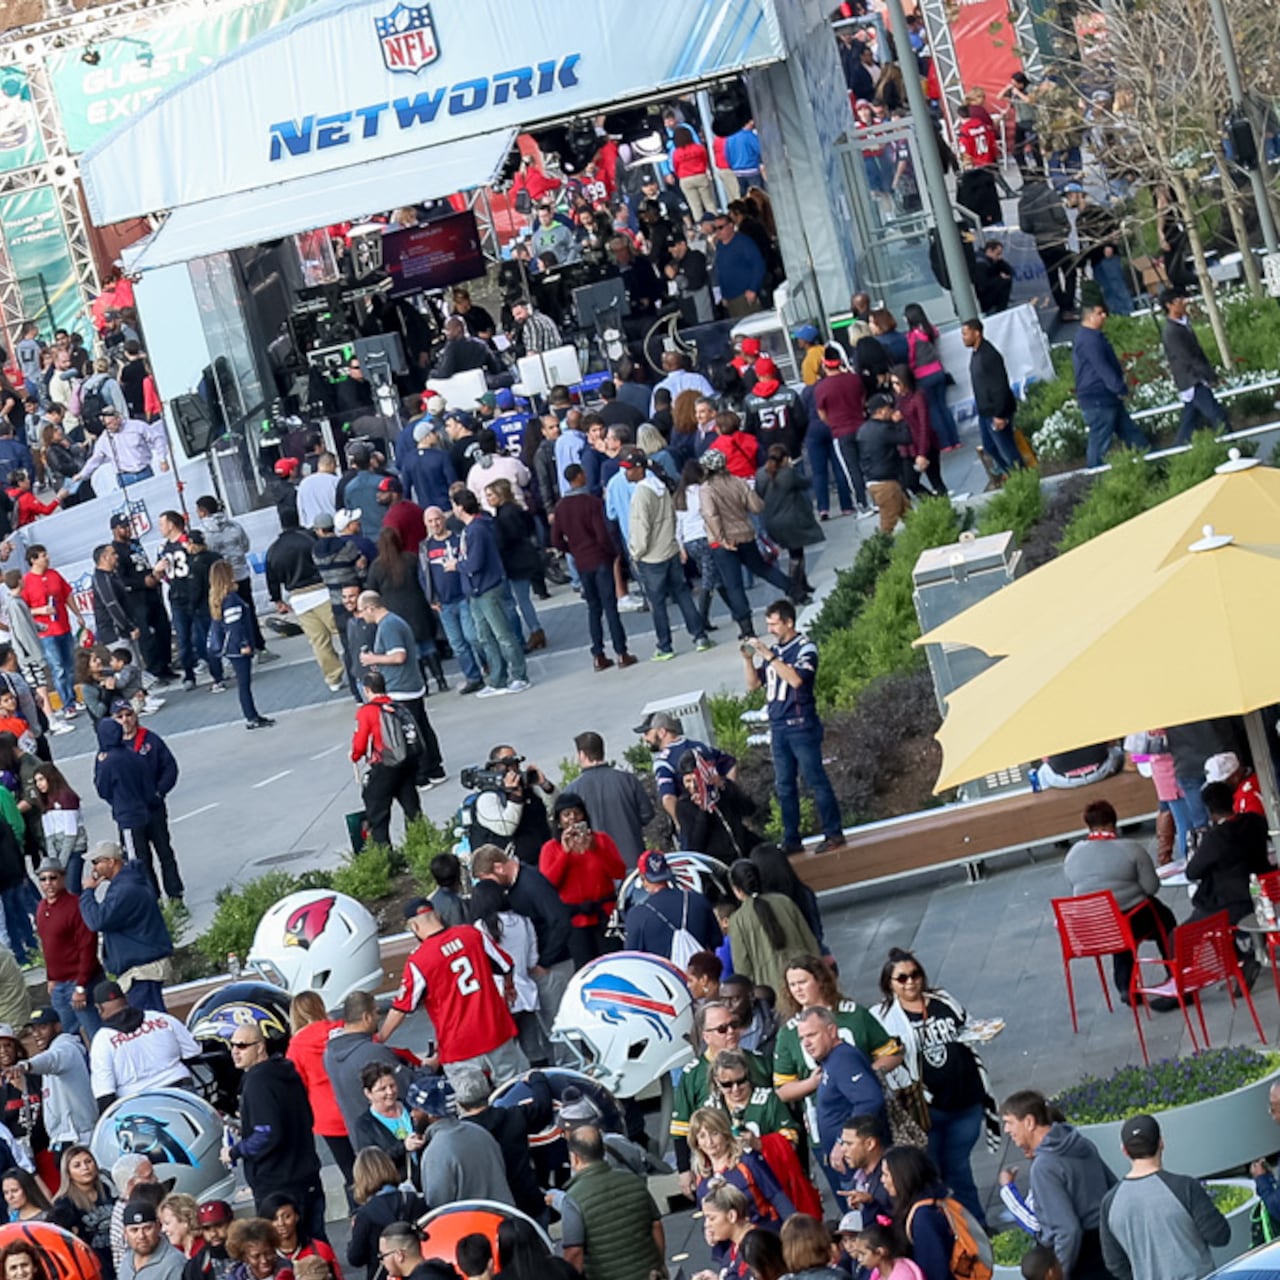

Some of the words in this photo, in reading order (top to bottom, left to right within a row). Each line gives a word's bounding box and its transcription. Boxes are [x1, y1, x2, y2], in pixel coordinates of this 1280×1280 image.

[384, 30, 434, 67] NFL
[82, 54, 190, 95] GUEST
[269, 53, 582, 161] NETWORK
[450, 956, 480, 996] 2
[110, 1017, 169, 1050] FALCONS
